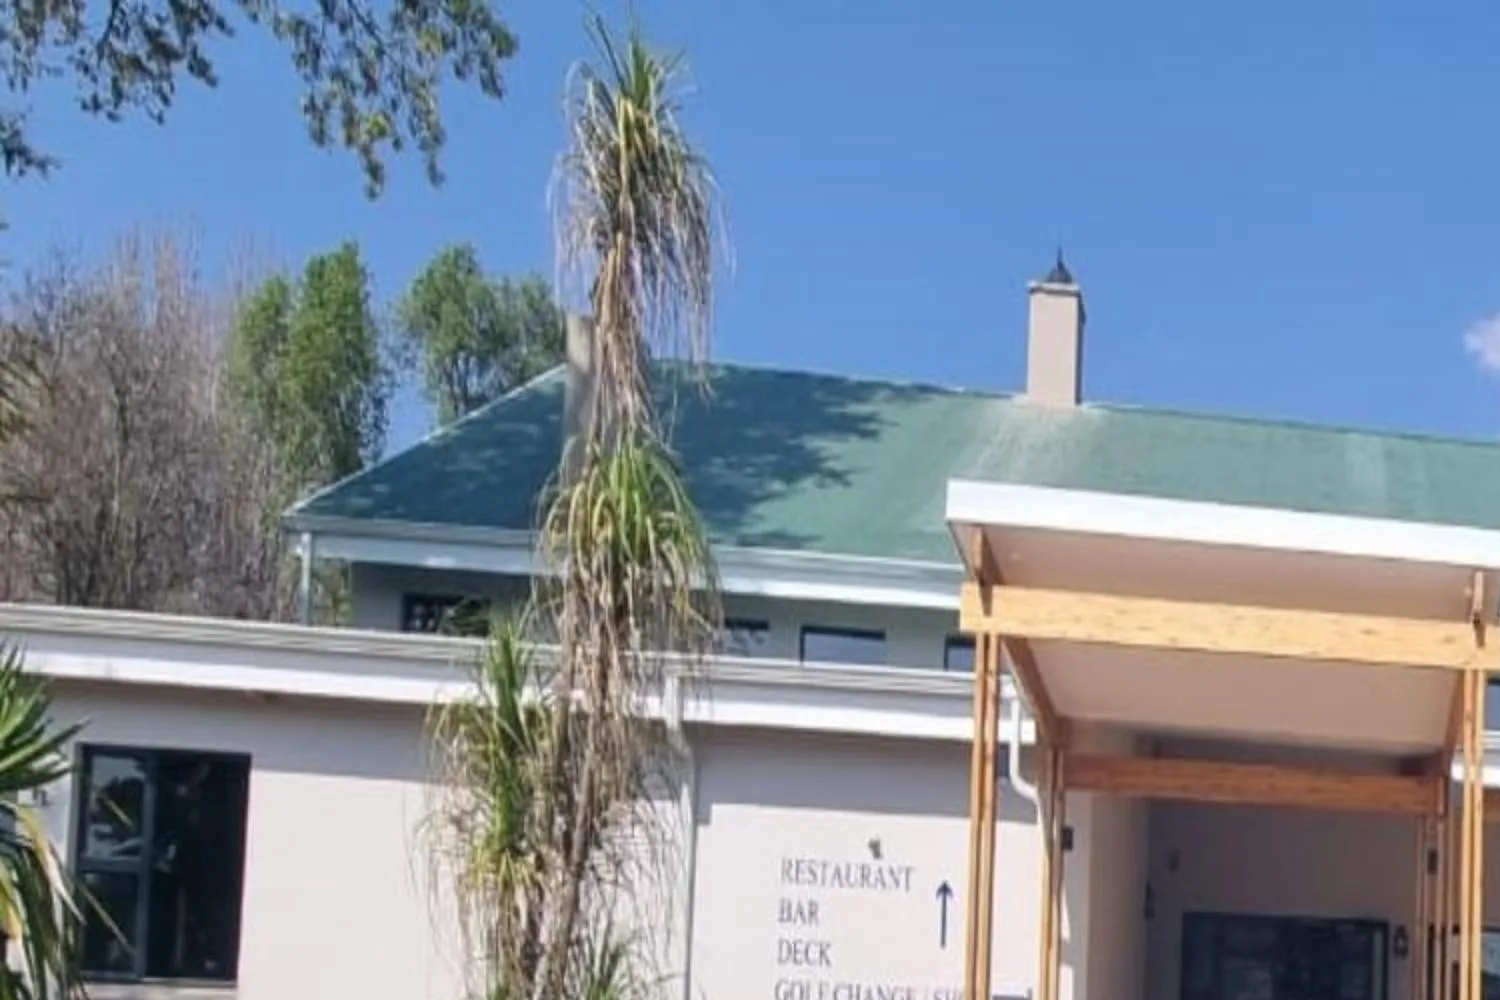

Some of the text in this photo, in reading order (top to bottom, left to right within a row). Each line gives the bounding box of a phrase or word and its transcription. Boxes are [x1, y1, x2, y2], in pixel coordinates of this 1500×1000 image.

[781, 857, 915, 893] RESTAURANT
[778, 897, 819, 925] BAR
[777, 938, 832, 967] DECK
